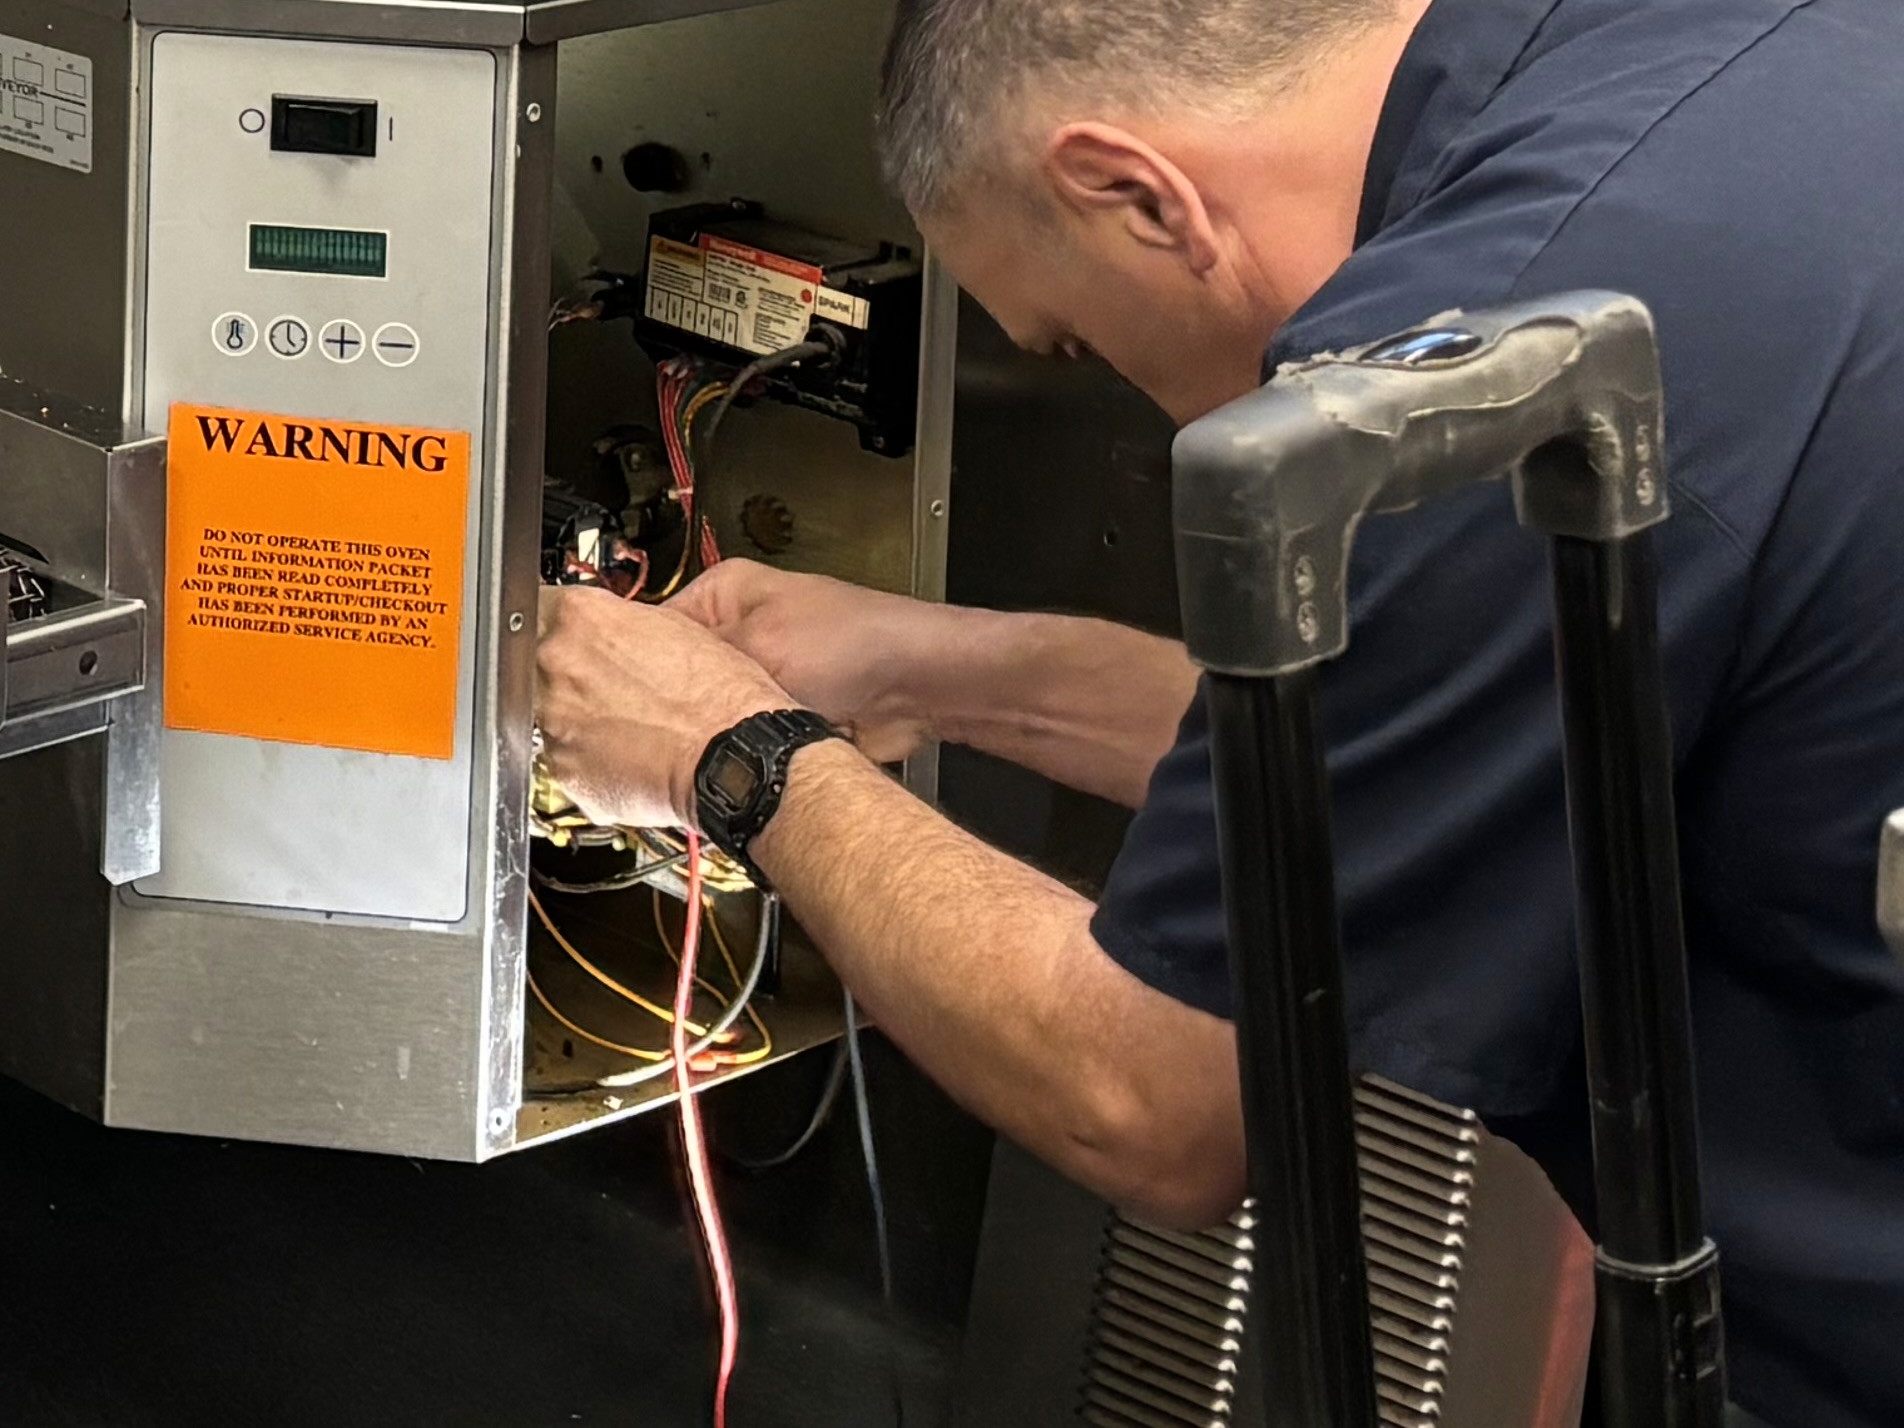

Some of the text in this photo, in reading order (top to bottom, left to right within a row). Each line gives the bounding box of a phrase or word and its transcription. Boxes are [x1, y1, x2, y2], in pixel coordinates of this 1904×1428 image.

[196, 415, 448, 472] WARNING
[204, 528, 431, 561] DO NOT OPERATE THIS OVEN
[197, 562, 432, 596] HAS BEEN READ COMPLETELY
[200, 545, 432, 579] UNTIL INFORMATION PACKET
[180, 578, 448, 615] AND PROPER STARTUP/CHECKOUT
[198, 597, 428, 630] HAS BEEN PERFORMED BY AN
[187, 613, 436, 648] AUTHORIZED SERVICE AGENCY.
